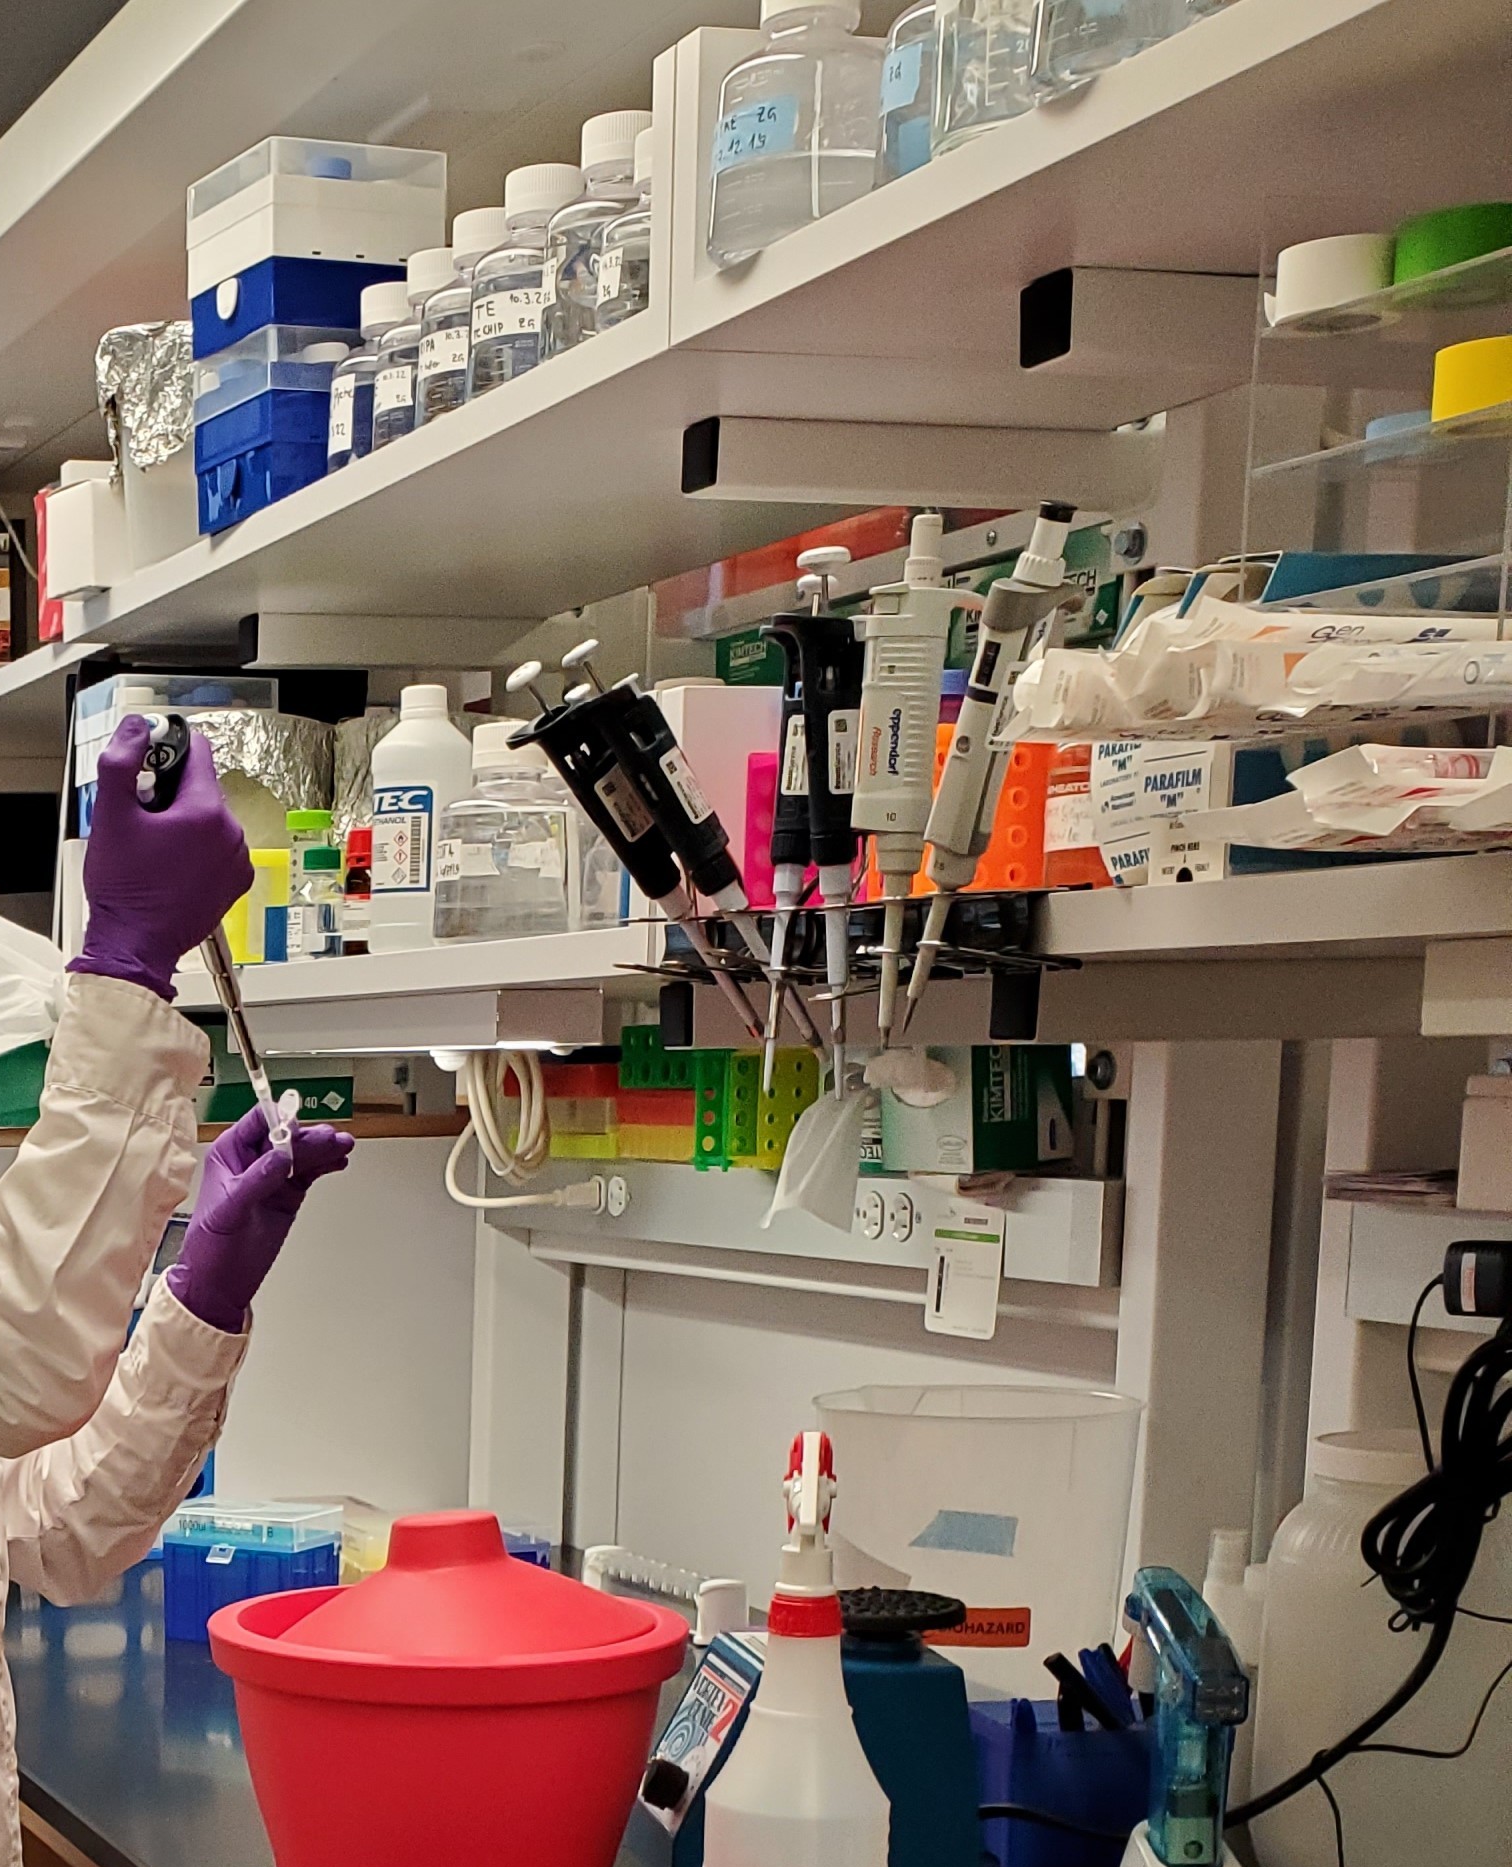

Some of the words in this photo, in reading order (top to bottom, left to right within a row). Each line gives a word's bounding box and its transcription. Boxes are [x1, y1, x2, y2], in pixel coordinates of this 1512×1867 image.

[475, 300, 496, 320] TE
[887, 707, 903, 776] eppendorf
[1143, 767, 1203, 793] PARAFILM
[940, 1621, 1026, 1635] OHAZARD
